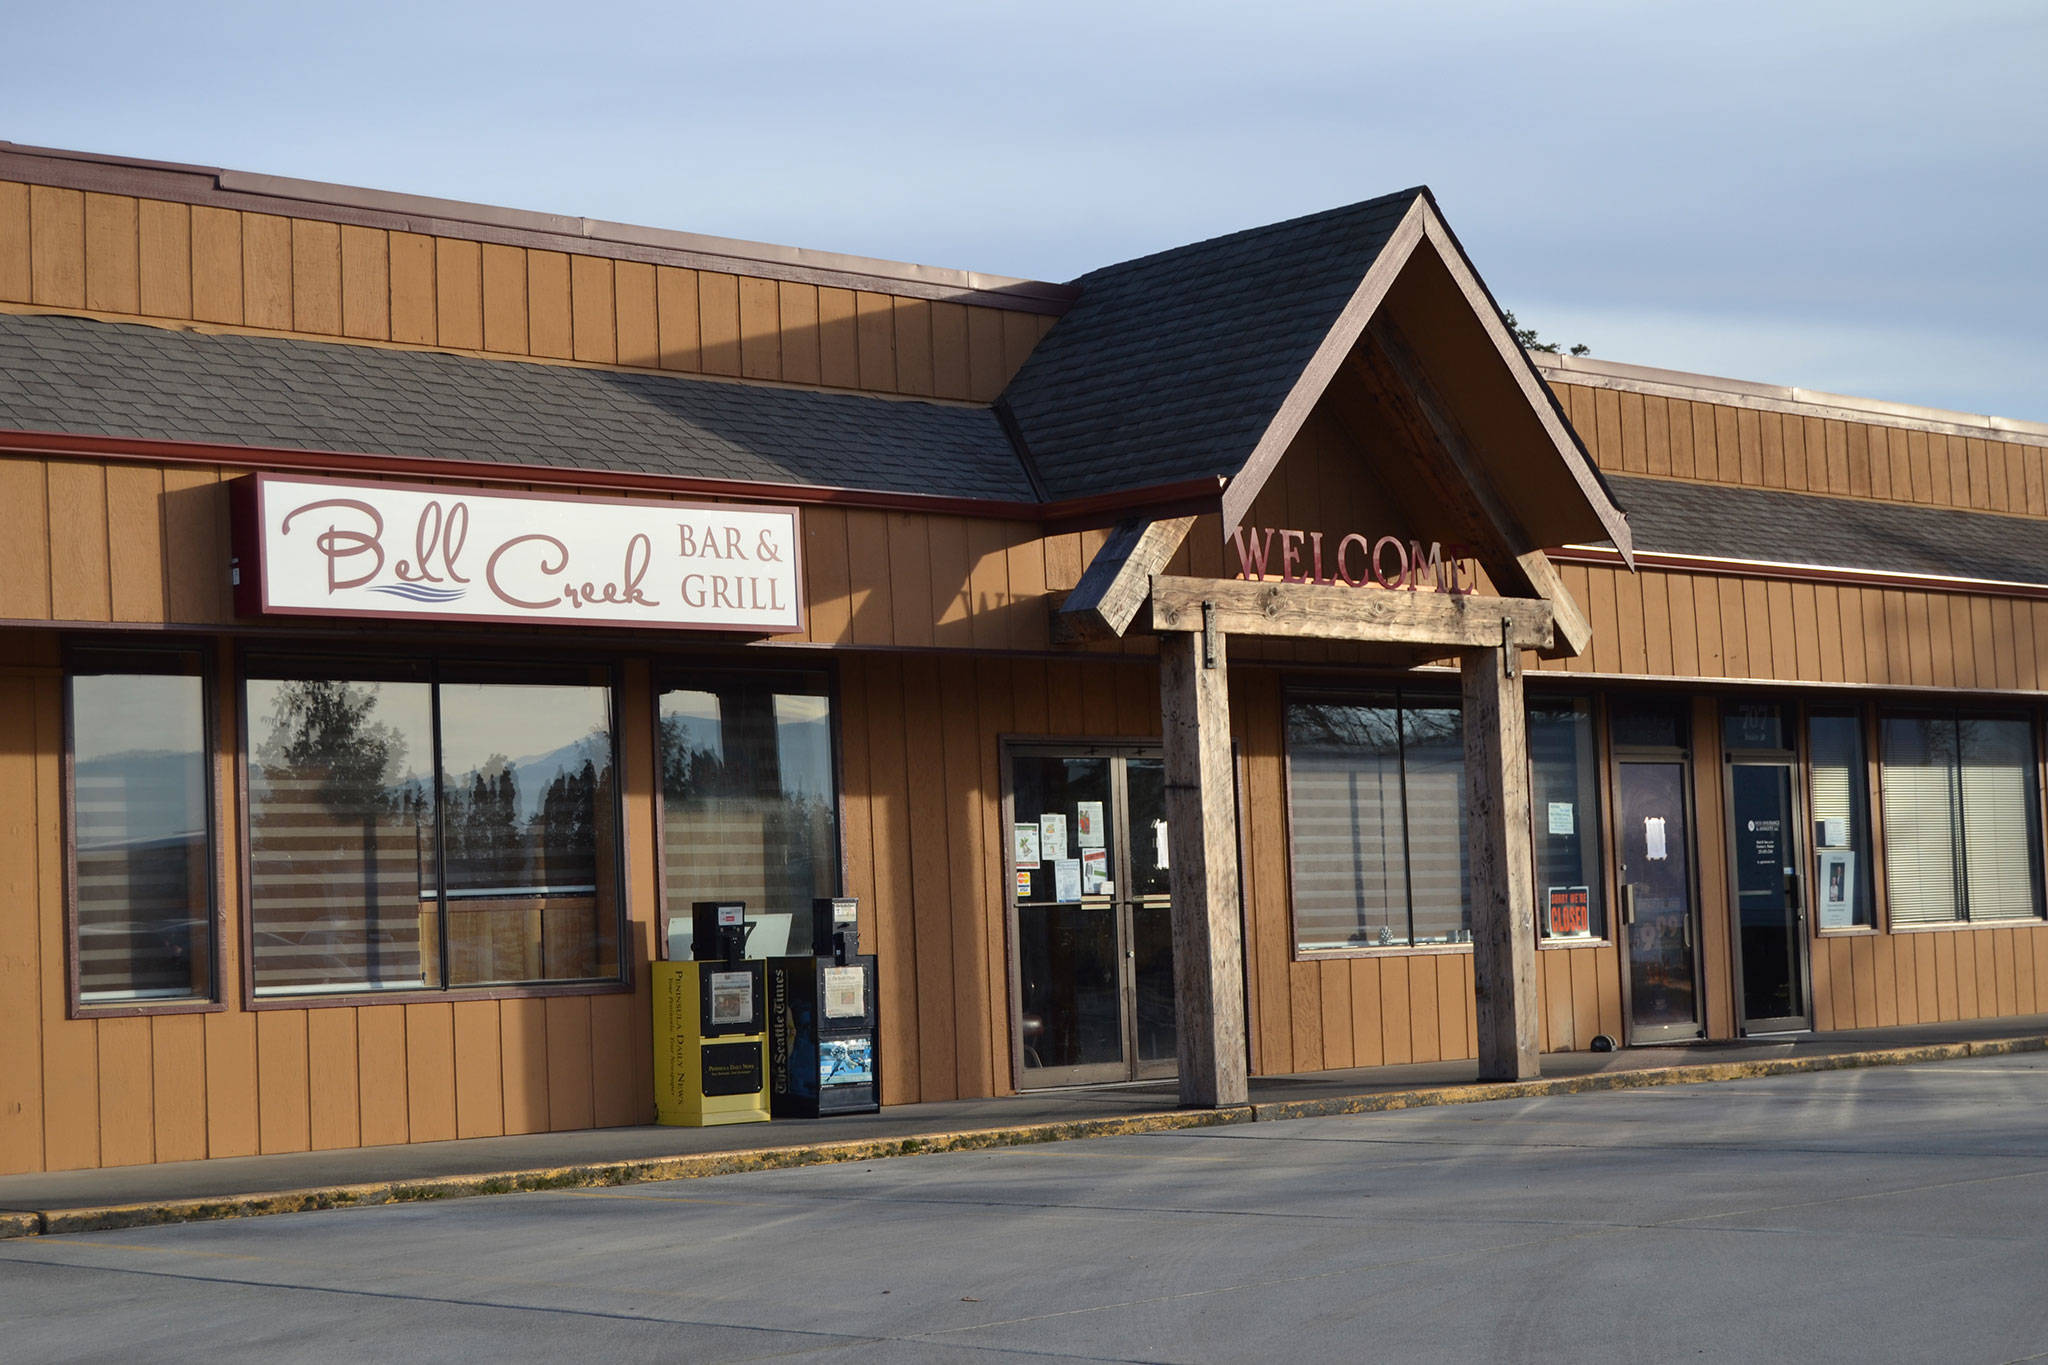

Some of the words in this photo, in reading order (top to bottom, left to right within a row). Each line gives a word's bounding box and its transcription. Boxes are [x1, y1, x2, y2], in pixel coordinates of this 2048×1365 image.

[281, 498, 471, 596] Bell
[485, 533, 660, 610] Creek
[677, 523, 749, 562] BAR
[756, 528, 784, 563] &
[1233, 525, 1475, 596] WELCOME
[680, 574, 787, 612] GRILL
[1551, 906, 1588, 933] CLOSED
[675, 970, 684, 1031] PENINSULA
[772, 969, 785, 1015] Times
[676, 1033, 685, 1069] DAILY
[774, 1015, 787, 1064] Seattle
[677, 1072, 686, 1105] NEWS
[774, 1066, 787, 1095] The
